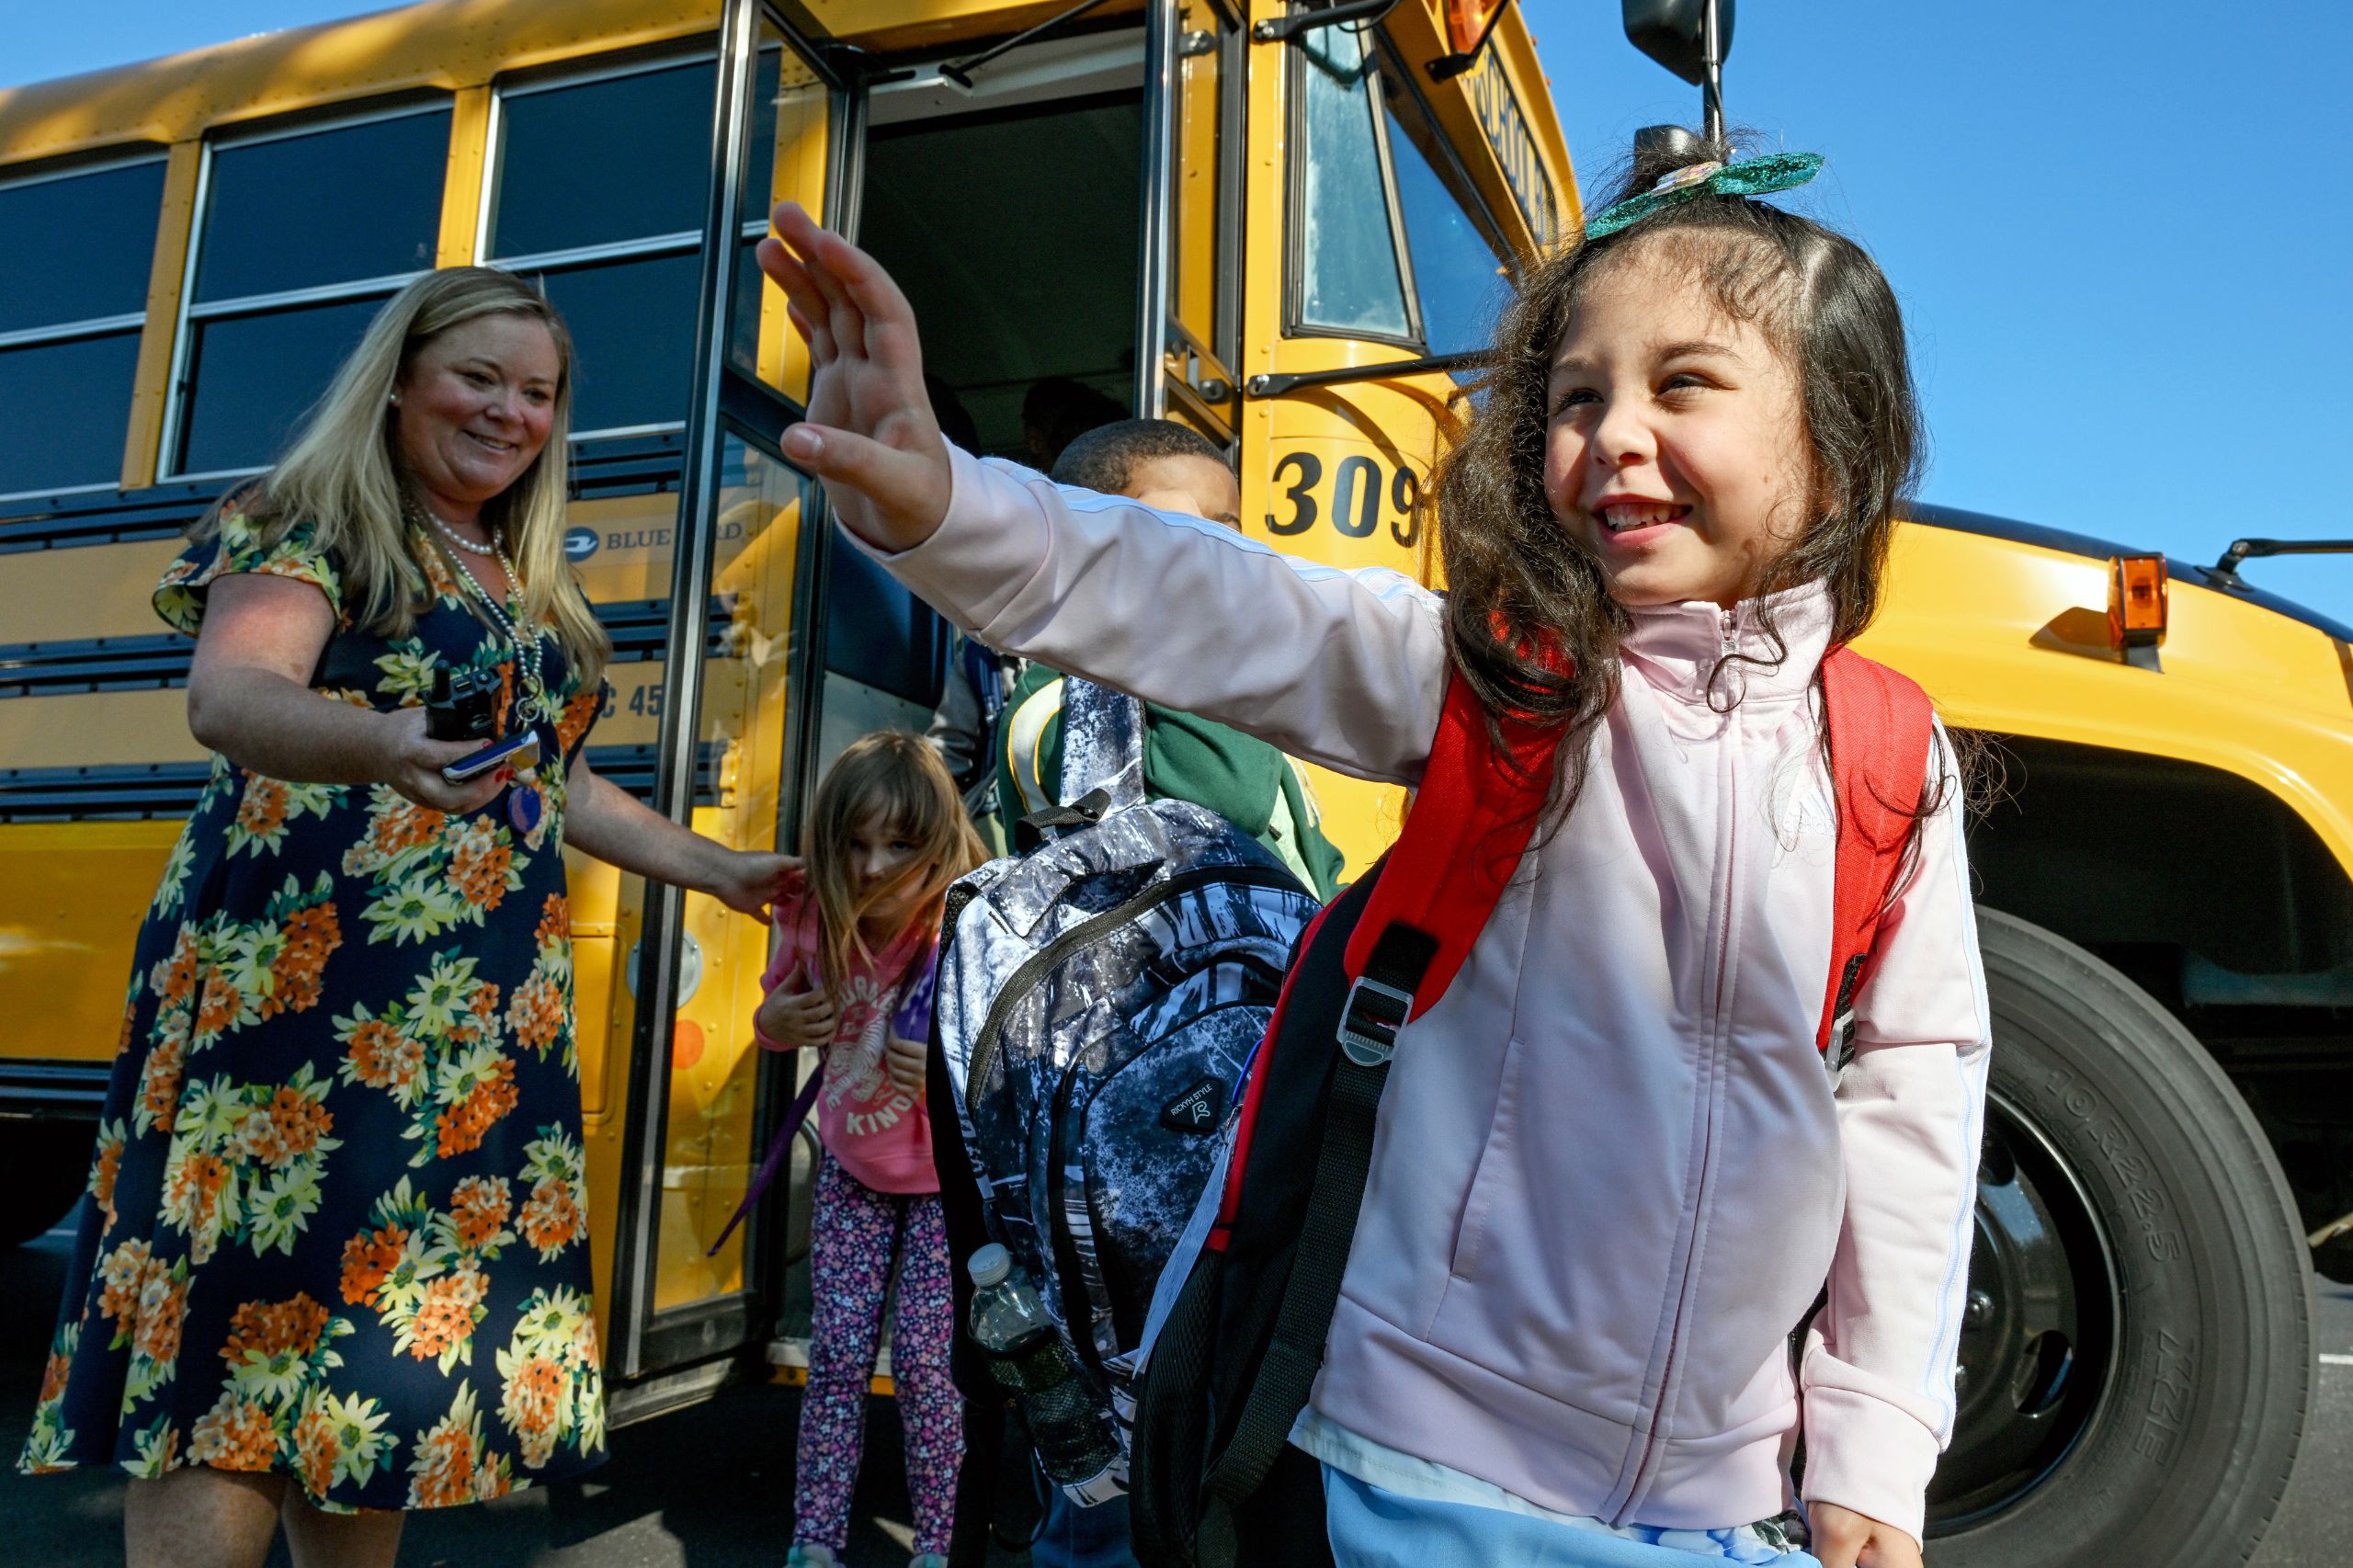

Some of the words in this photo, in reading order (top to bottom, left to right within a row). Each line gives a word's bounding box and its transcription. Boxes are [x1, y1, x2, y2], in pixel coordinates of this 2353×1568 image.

[1265, 451, 1419, 549] 309
[607, 528, 671, 550] BLUE
[846, 1095, 913, 1136] KIND
[1170, 1096, 1194, 1116] RICKYH
[1192, 1084, 1212, 1100] STYLE
